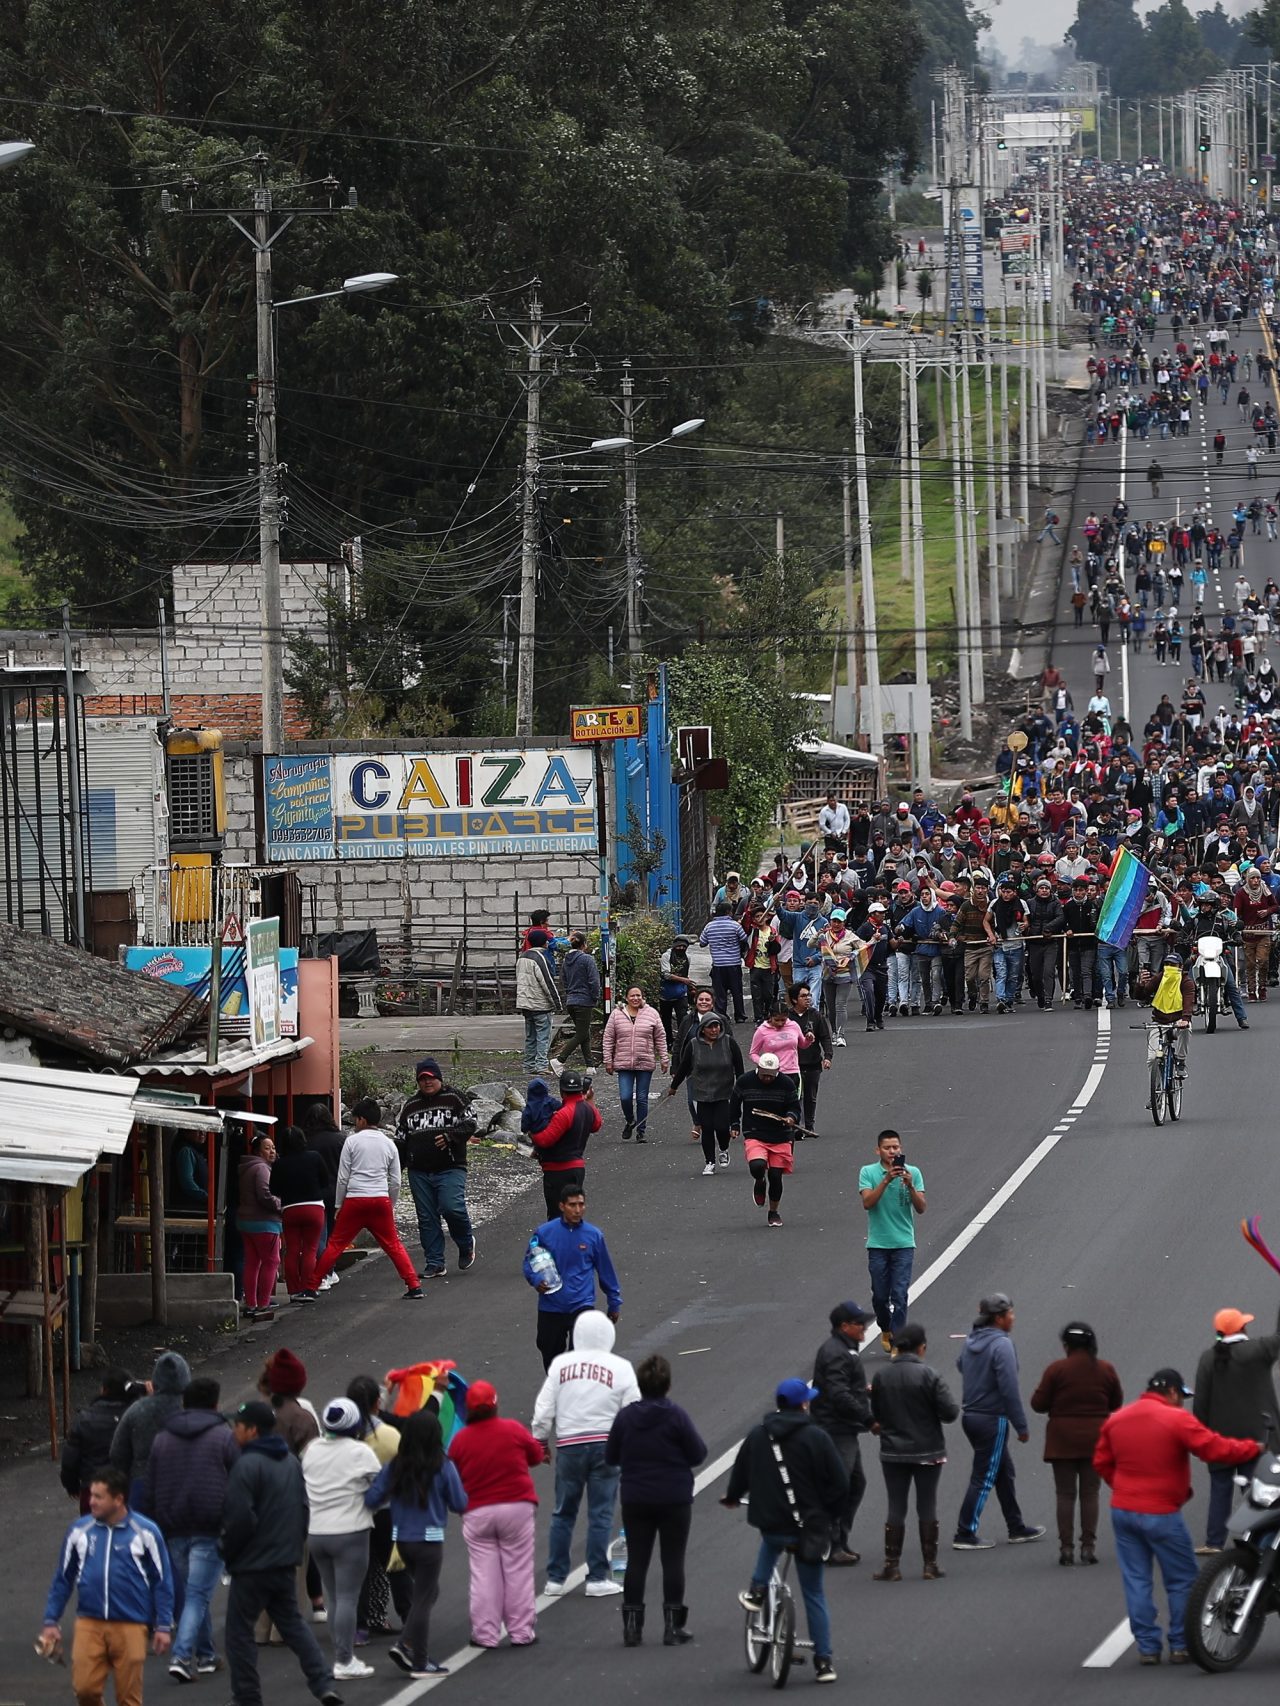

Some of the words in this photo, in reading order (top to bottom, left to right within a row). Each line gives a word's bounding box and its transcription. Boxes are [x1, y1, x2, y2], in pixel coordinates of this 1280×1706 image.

[576, 712, 618, 727] ARTE
[350, 756, 592, 810] CAIZA
[560, 1362, 613, 1389] HILFIGER
